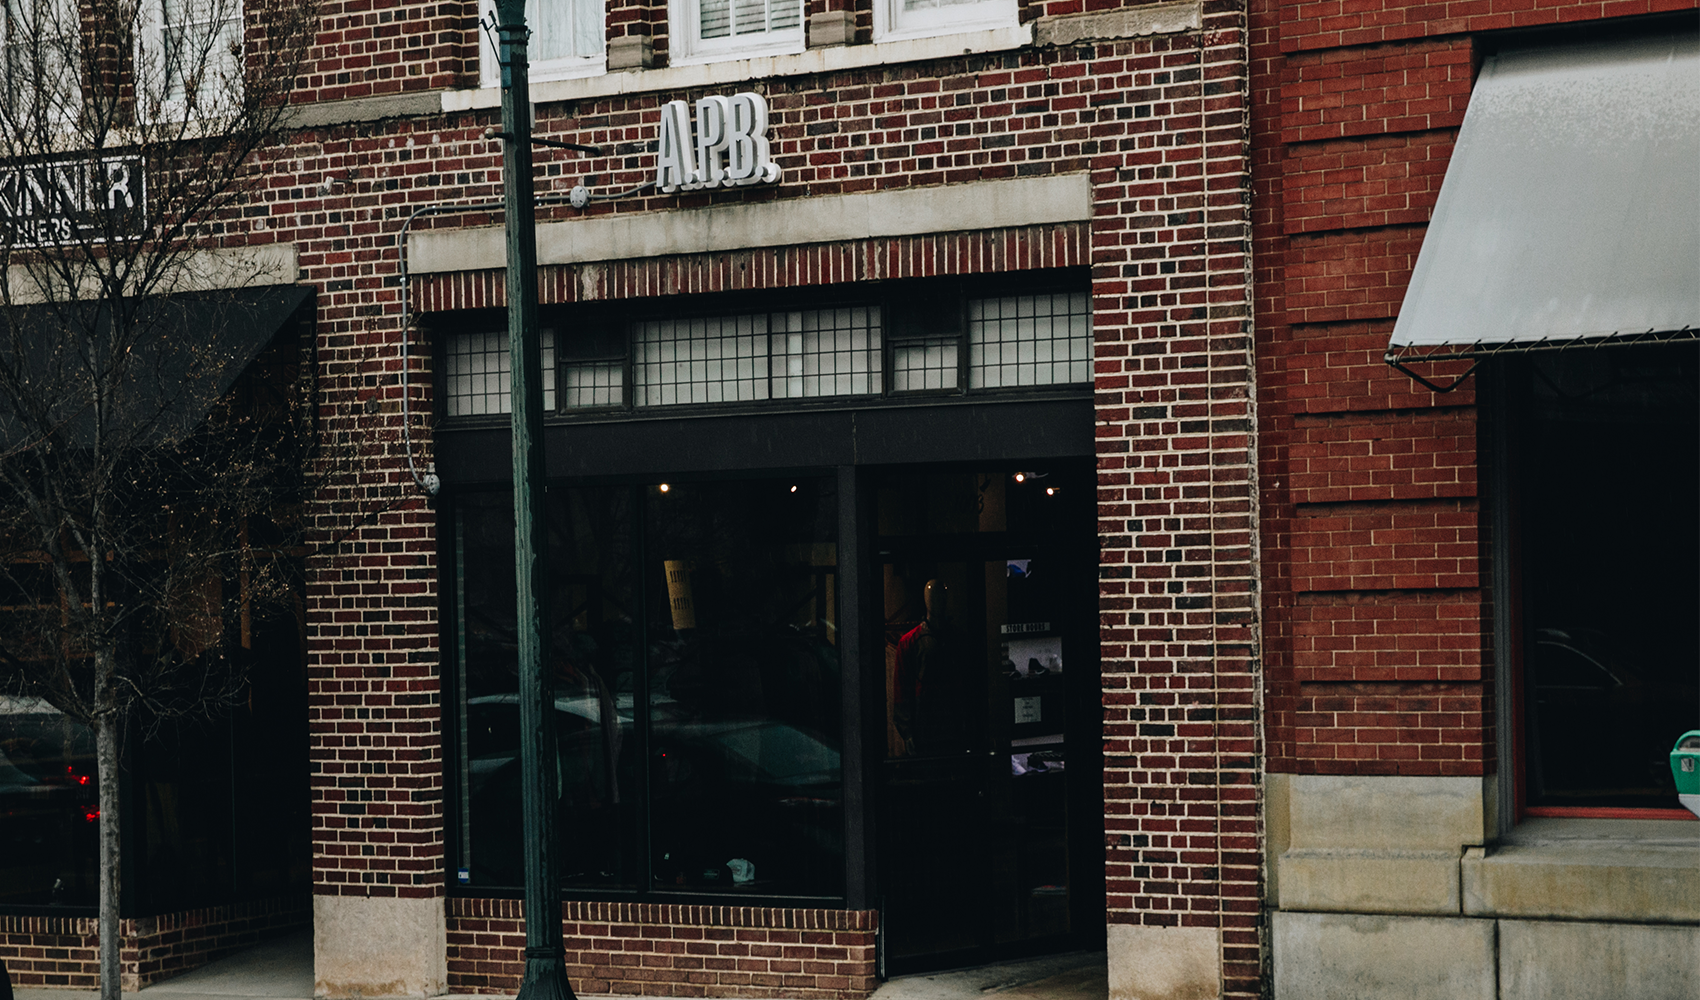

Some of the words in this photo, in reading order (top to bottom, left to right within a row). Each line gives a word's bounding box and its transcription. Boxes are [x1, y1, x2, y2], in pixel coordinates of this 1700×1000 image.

[656, 92, 781, 193] A.P.B.
[1006, 623, 1024, 633] STORE
[1026, 622, 1045, 632] HOURS
